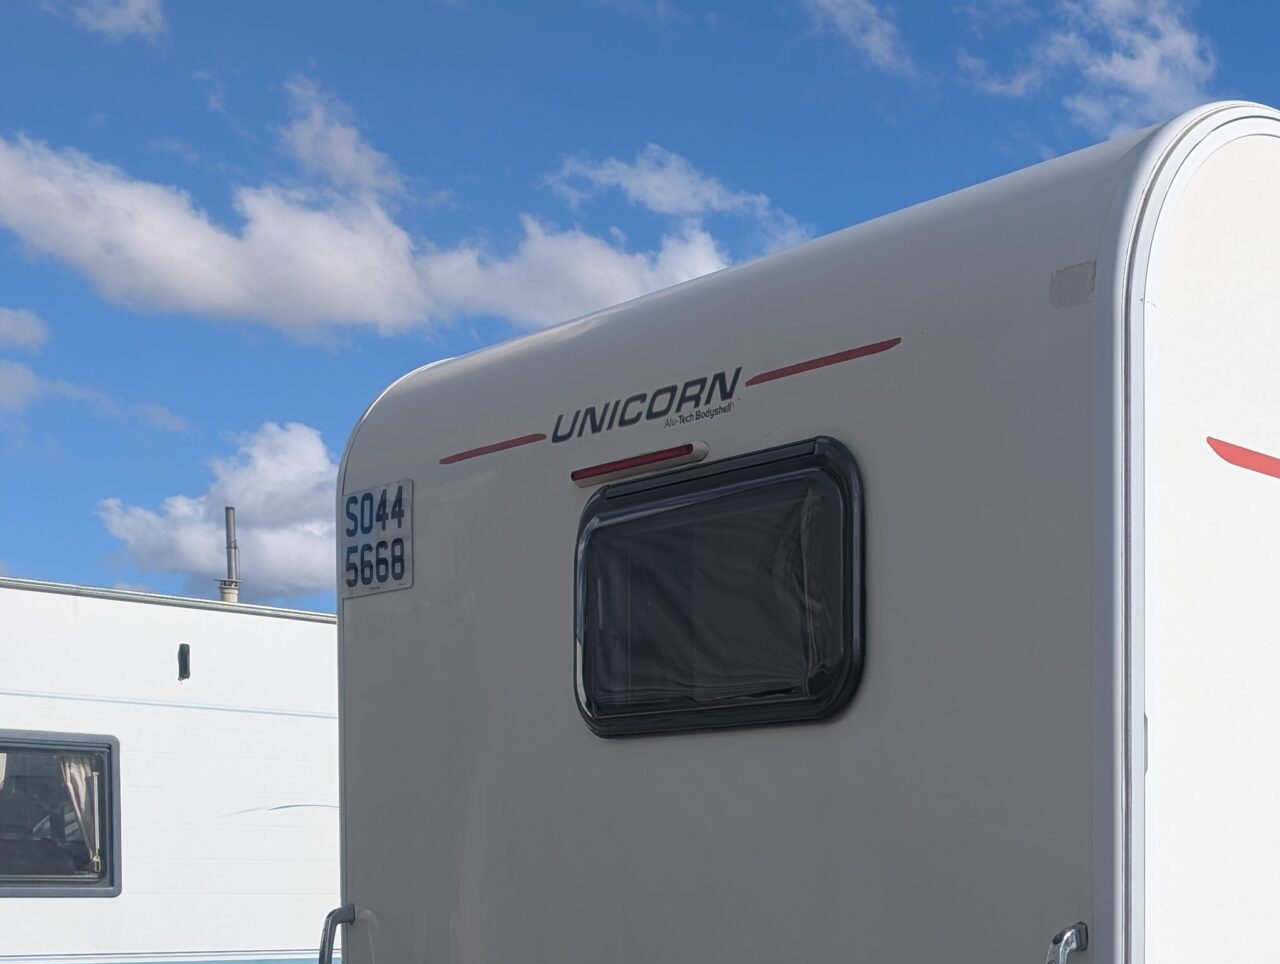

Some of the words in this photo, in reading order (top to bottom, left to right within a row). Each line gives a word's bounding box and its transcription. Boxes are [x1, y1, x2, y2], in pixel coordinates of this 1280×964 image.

[551, 366, 743, 444] UNICORN
[664, 412, 694, 429] Alu-Tech
[345, 537, 405, 588] 5668
